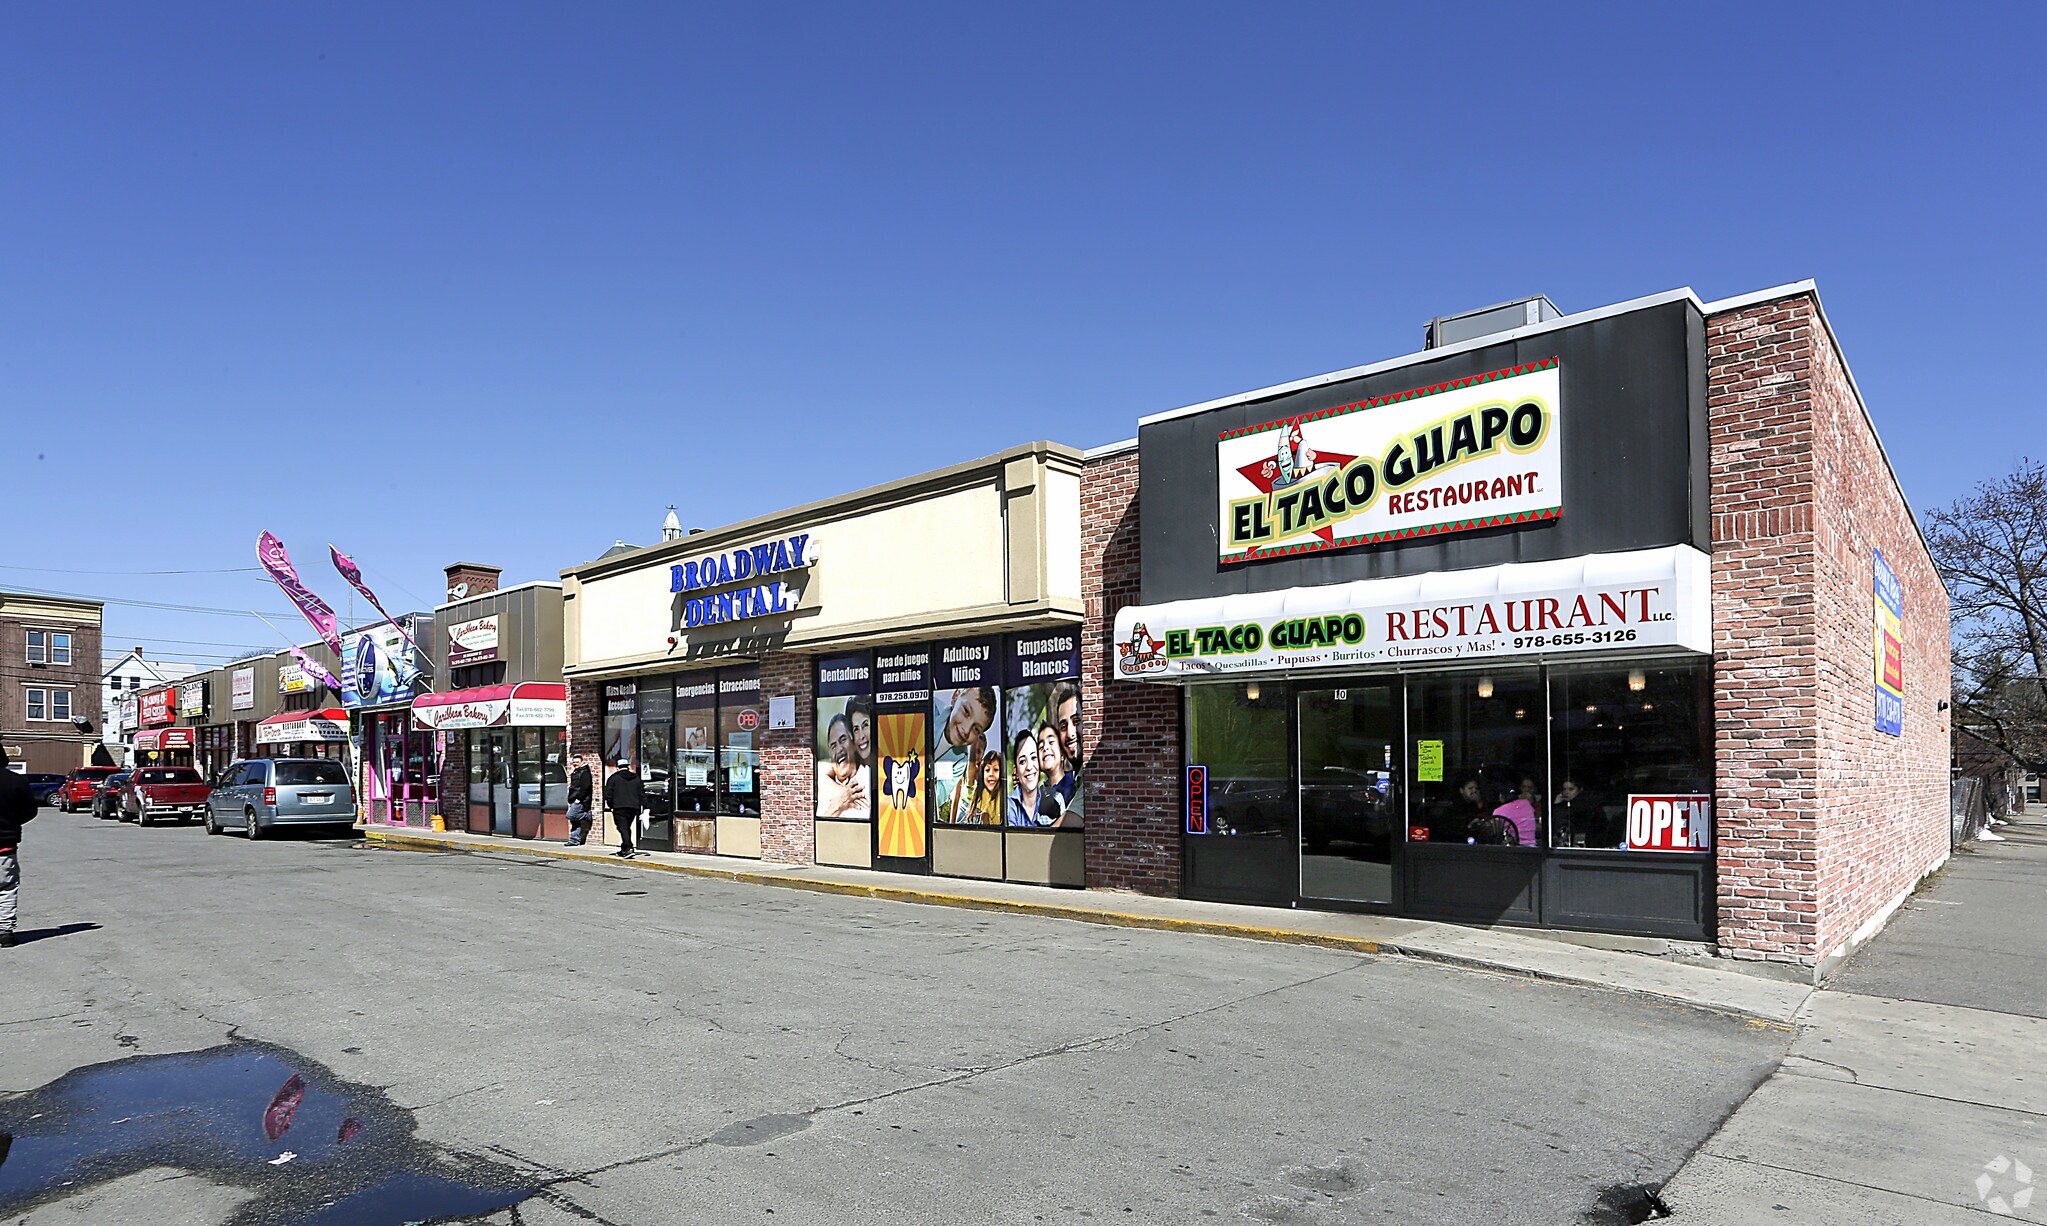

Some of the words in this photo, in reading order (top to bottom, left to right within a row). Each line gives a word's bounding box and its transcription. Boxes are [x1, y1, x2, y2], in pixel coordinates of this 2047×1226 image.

[1234, 504, 1271, 541] EL
[1276, 463, 1375, 532] TACO
[1382, 403, 1542, 486] GUAPO
[1388, 471, 1539, 516] RESTAURANT
[670, 534, 809, 593] BROADWAY
[686, 581, 787, 627] DENTAL
[1386, 587, 1659, 642] RESTAURANT
[479, 619, 497, 633] Bakery
[1017, 636, 1073, 657] Empastes
[1168, 632, 1194, 657] EL
[1196, 626, 1261, 654] TACO
[1270, 616, 1365, 648] GUAPO
[1513, 629, 1637, 649] 978-655-3126
[876, 656, 893, 669] Area
[894, 655, 903, 667] de
[904, 653, 928, 667] juegos
[943, 645, 982, 663] Adultos
[983, 645, 990, 660] y
[1179, 660, 1206, 671] Tacos
[1214, 658, 1268, 671] Quesadillas
[1277, 654, 1321, 666] Pupusas
[1332, 649, 1376, 661] Burritos
[1387, 643, 1453, 658] Churrascos
[1455, 645, 1463, 656] y
[1467, 640, 1496, 652] Mas!
[820, 666, 869, 683] Dentaduras
[882, 672, 900, 685] para
[900, 668, 921, 682] niños
[951, 665, 981, 683] Niños
[1022, 659, 1070, 678] Blancos
[676, 682, 715, 698] Emergencias
[719, 678, 761, 693] Extracciones
[1334, 689, 1347, 700] 10
[879, 691, 928, 701] 978.258.0970
[433, 705, 463, 727] Caribbean
[463, 704, 488, 725] Bakery
[1189, 768, 1204, 832] OPEN
[1630, 799, 1709, 848] OPEN
